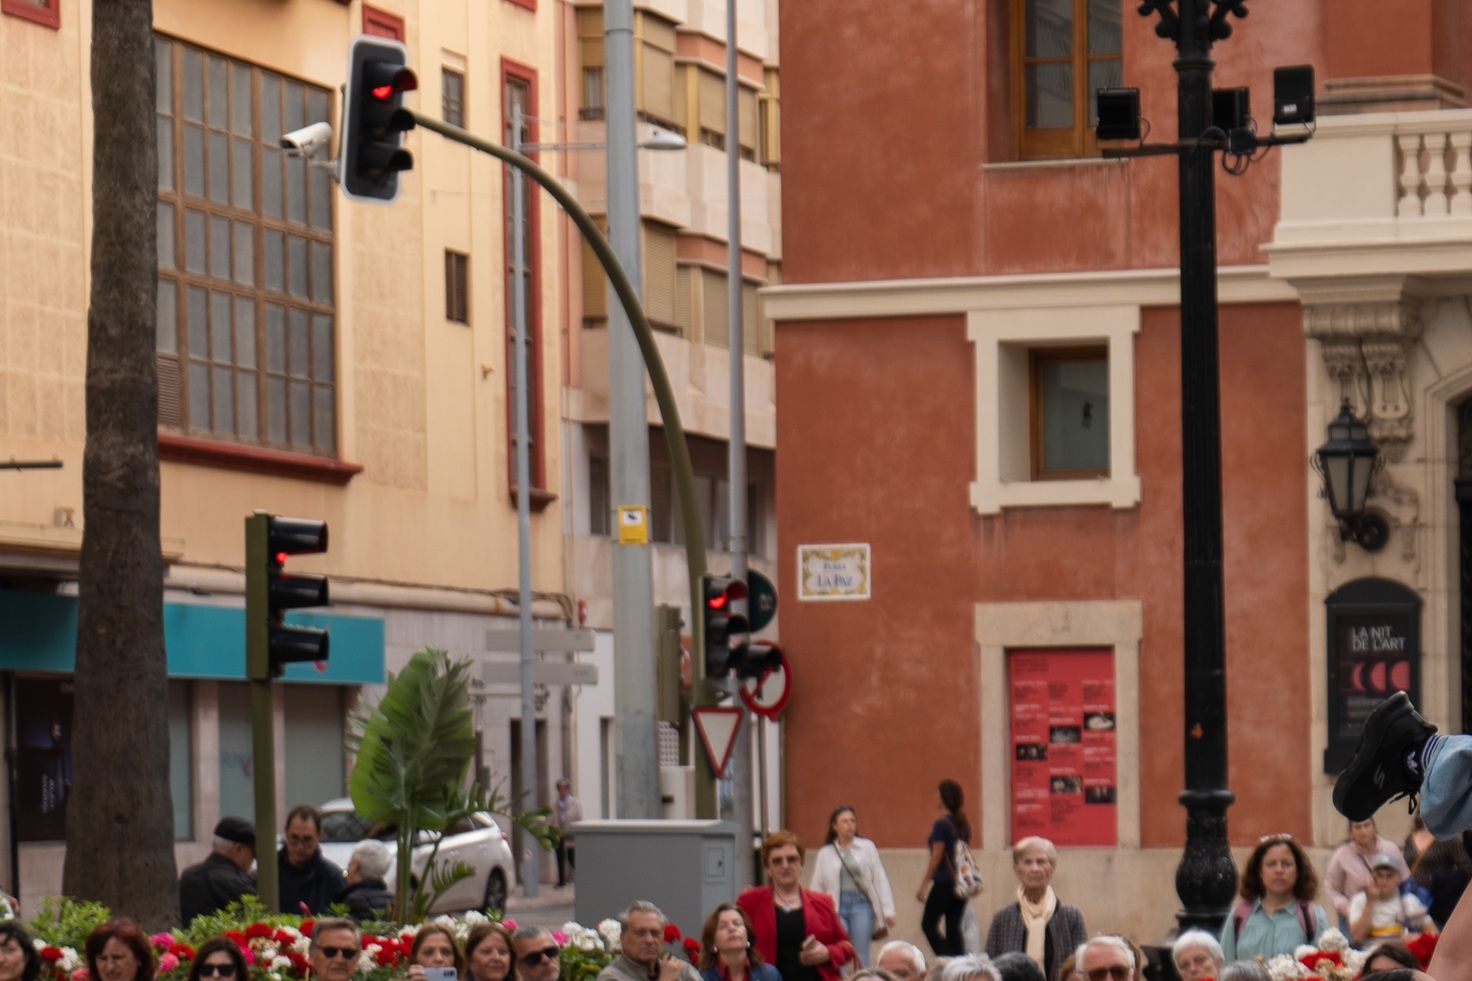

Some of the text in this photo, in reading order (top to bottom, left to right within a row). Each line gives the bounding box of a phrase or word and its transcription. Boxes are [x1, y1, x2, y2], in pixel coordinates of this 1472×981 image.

[1352, 625, 1393, 639] LA NIT
[1352, 637, 1406, 651] DE L'ART
